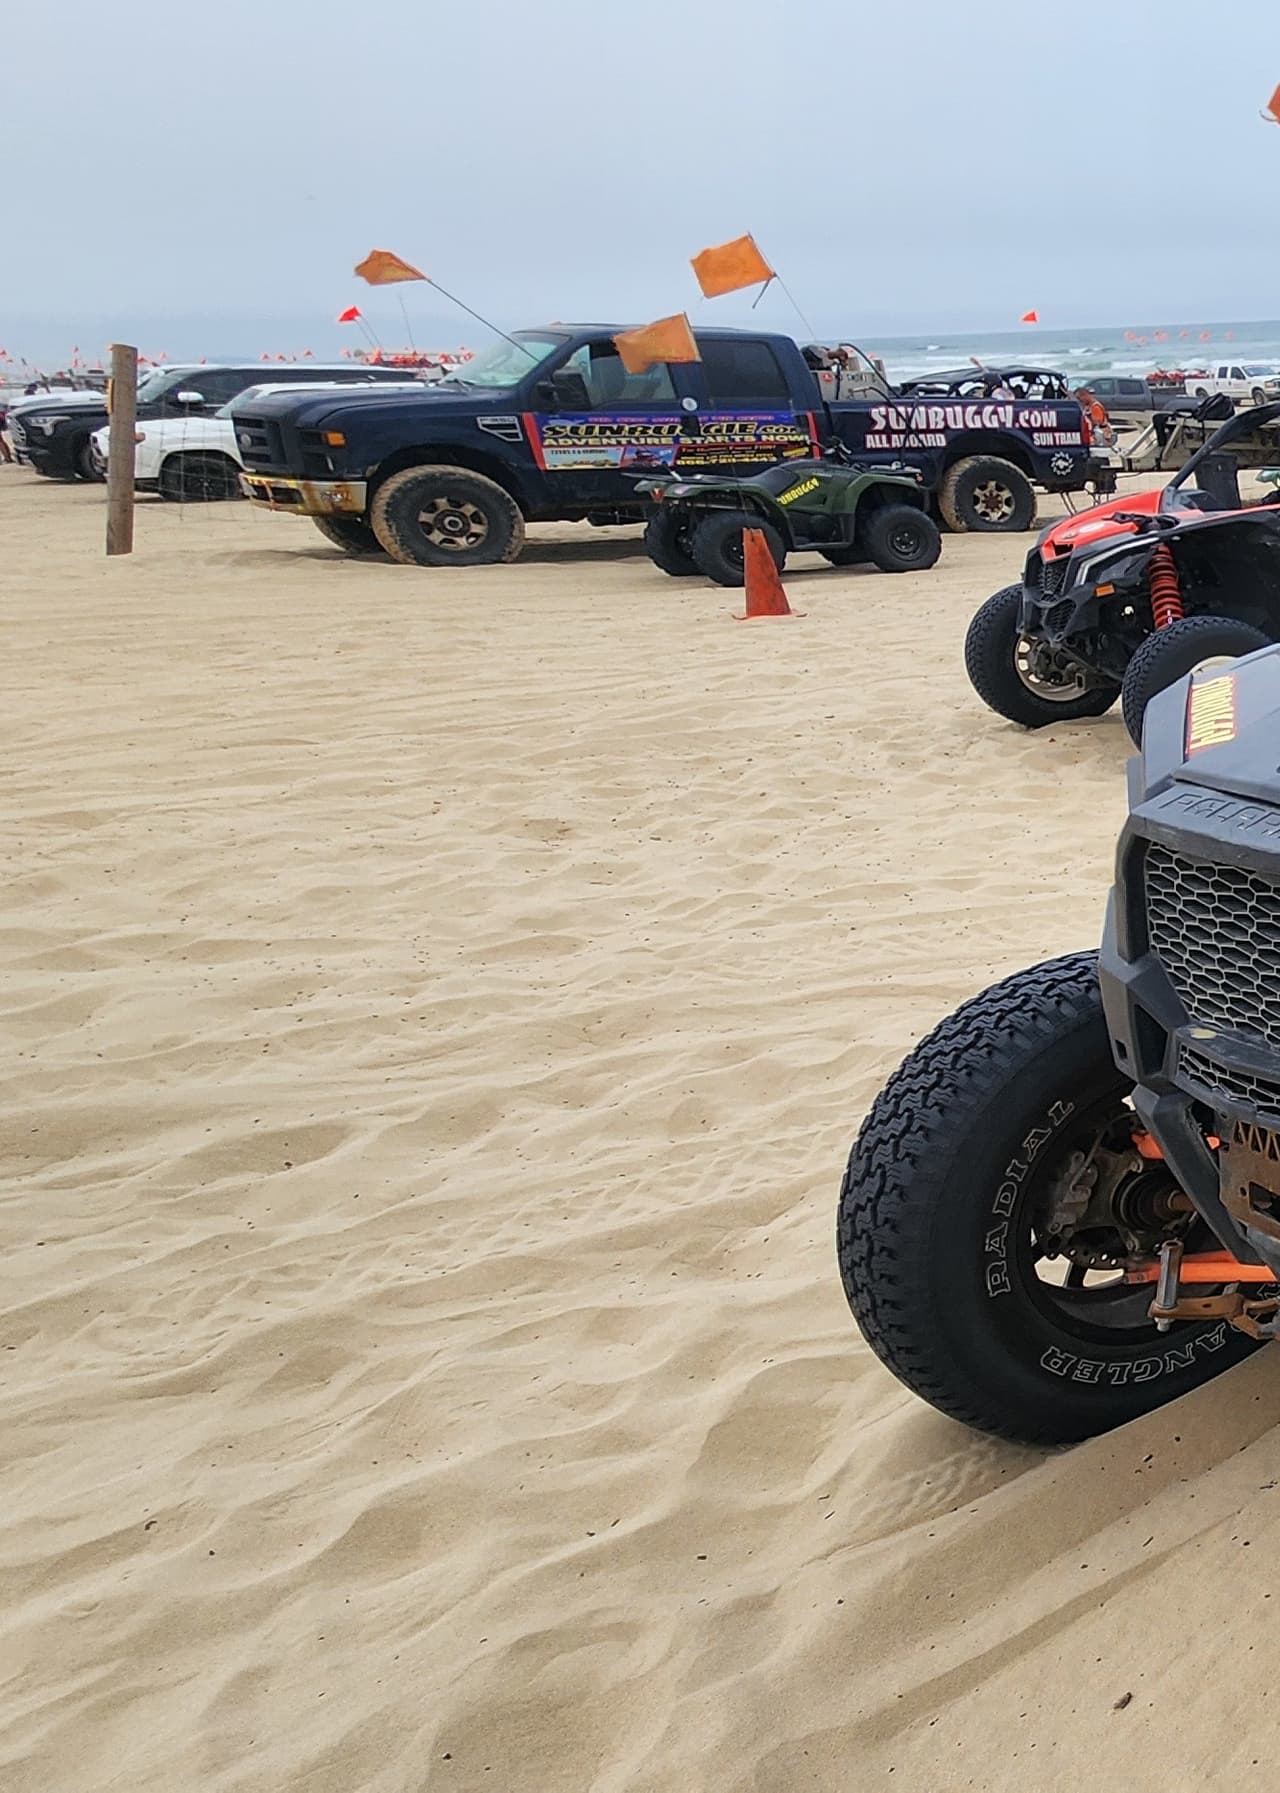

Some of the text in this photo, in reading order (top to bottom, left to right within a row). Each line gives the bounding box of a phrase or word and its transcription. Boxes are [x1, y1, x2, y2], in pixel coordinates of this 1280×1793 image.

[543, 437, 673, 446] ADVENTURE
[680, 435, 756, 444] STARTS
[865, 433, 889, 449] ALL
[1032, 432, 1052, 446] SUN
[1054, 432, 1081, 446] TRAM
[776, 477, 820, 505] UNBUGGY
[985, 1100, 1075, 1297] RADIAL
